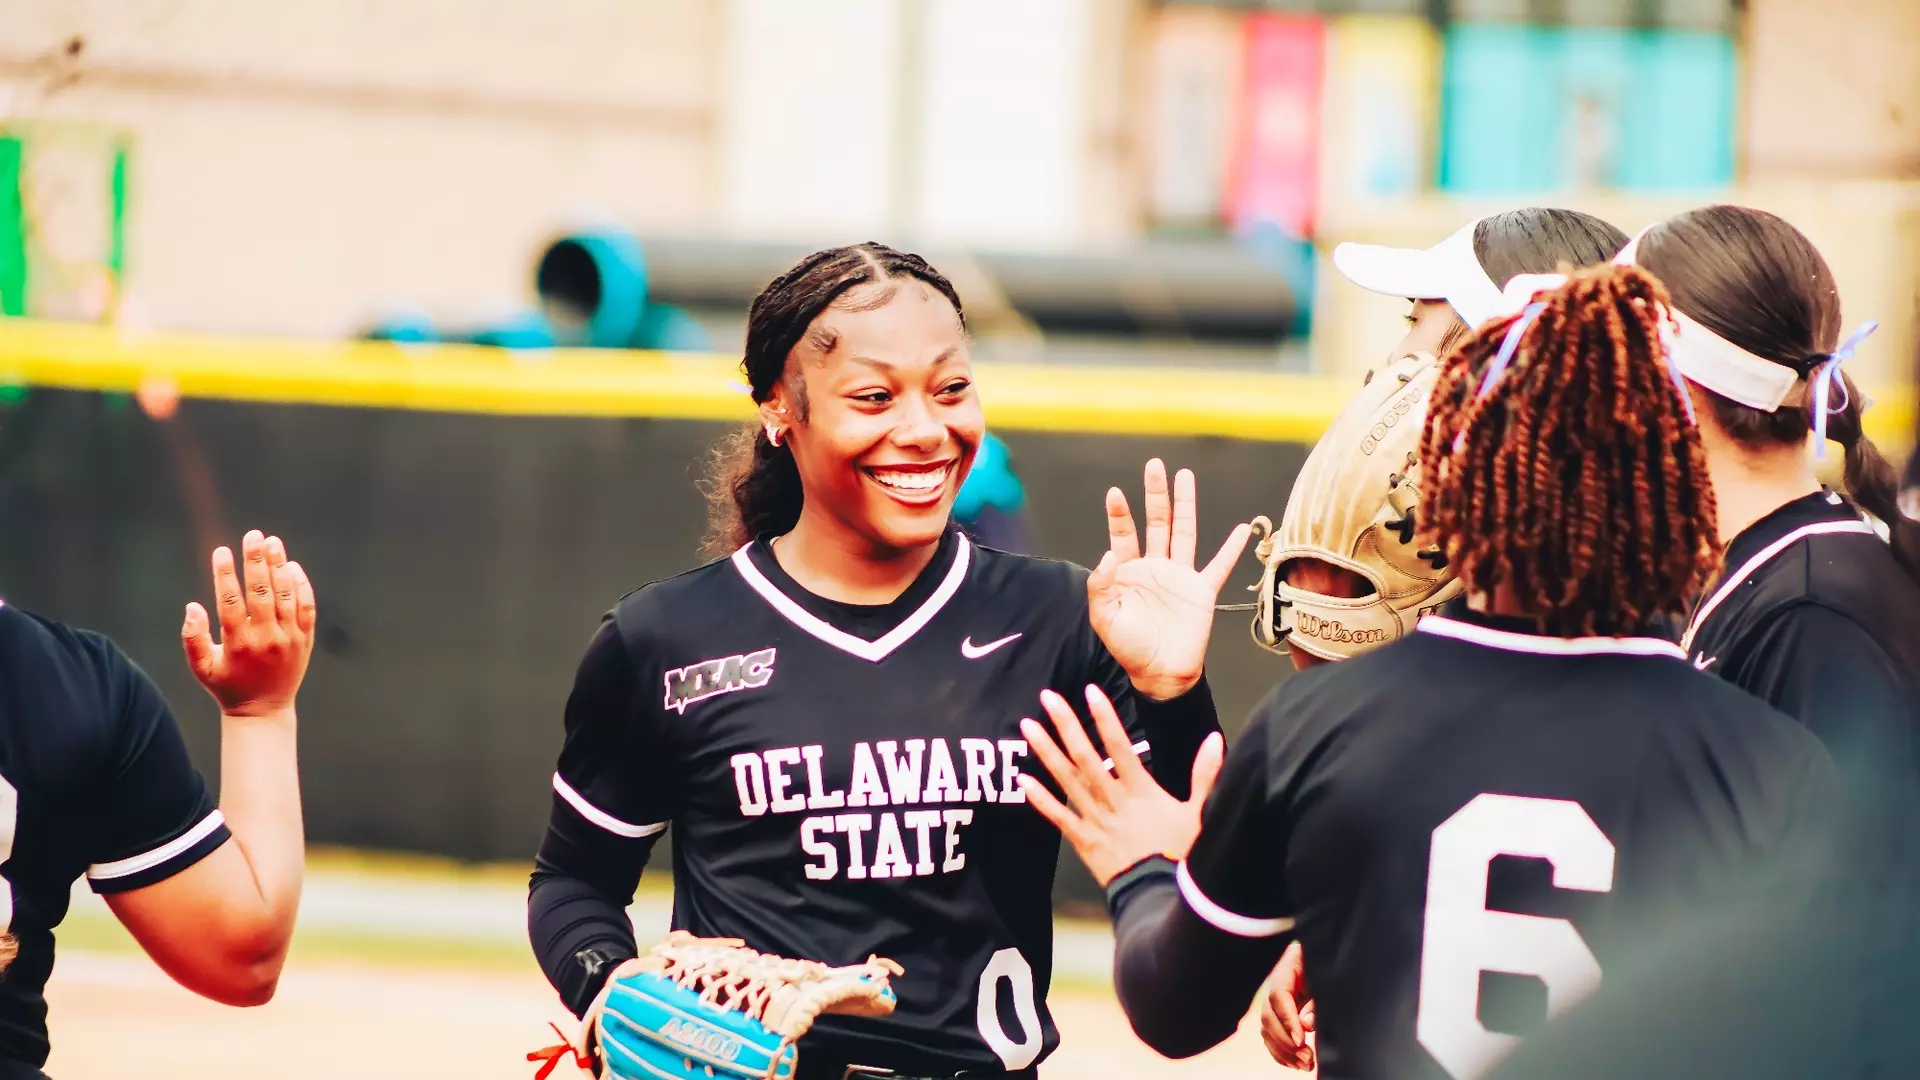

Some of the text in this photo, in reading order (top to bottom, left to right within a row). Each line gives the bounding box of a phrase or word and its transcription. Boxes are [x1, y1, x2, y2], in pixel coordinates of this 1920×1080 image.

[1360, 387, 1421, 456] A2000
[1296, 610, 1389, 643] Wilson
[664, 647, 776, 715] MEAC
[730, 738, 1028, 816] DELAWARE
[800, 809, 974, 880] STATE
[1416, 792, 1616, 1080] 6
[658, 1016, 742, 1062] A2000
[977, 946, 1043, 1071] 0
